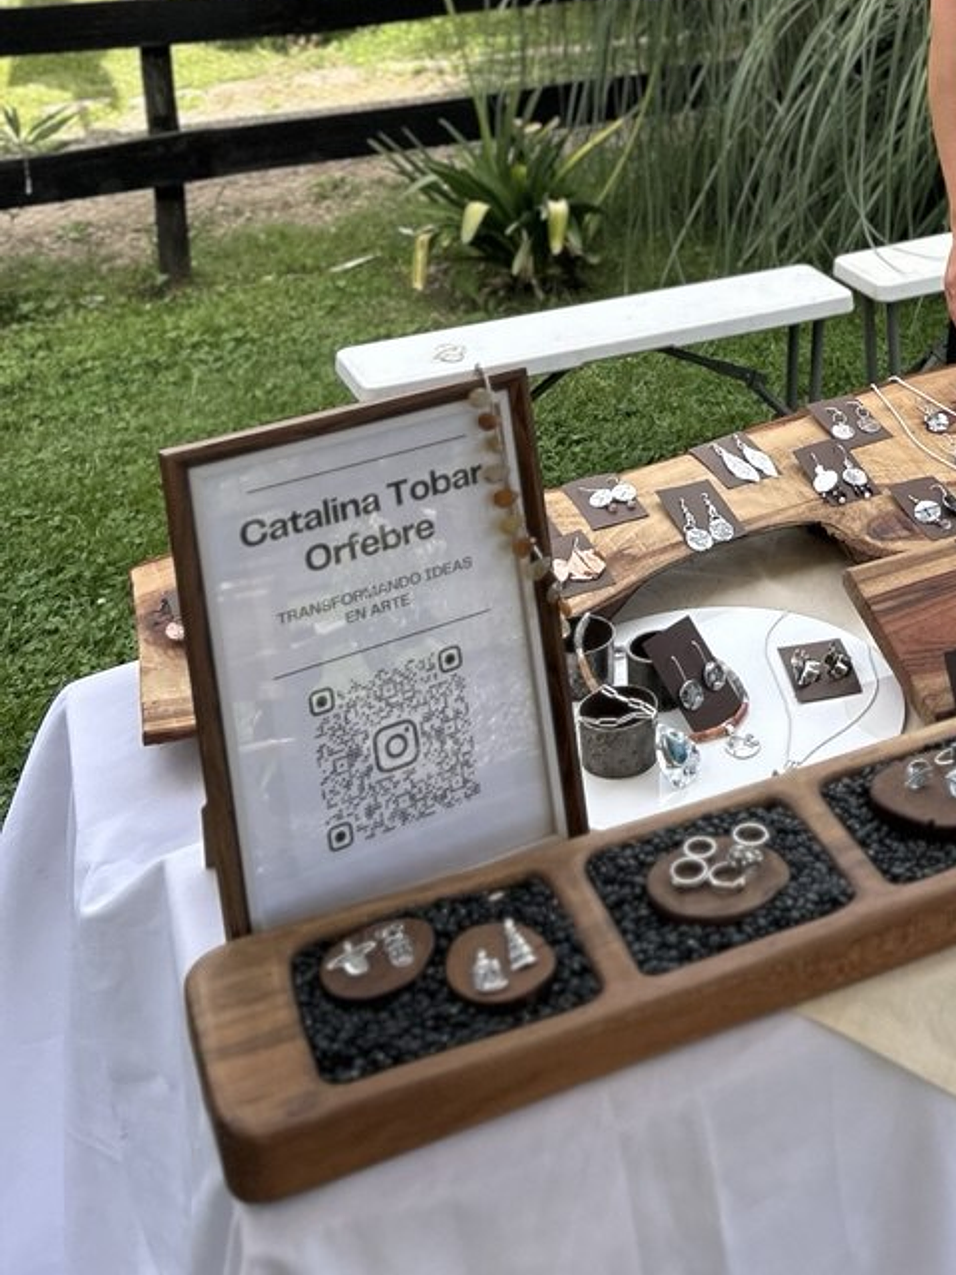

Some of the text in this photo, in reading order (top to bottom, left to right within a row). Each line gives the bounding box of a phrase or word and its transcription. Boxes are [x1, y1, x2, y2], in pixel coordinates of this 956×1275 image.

[239, 463, 483, 547] Catalina Tobar
[304, 518, 435, 571] Orfebre
[276, 556, 473, 624] TRANSFORMANDO IDEAS
[344, 592, 412, 624] EN ARTE
